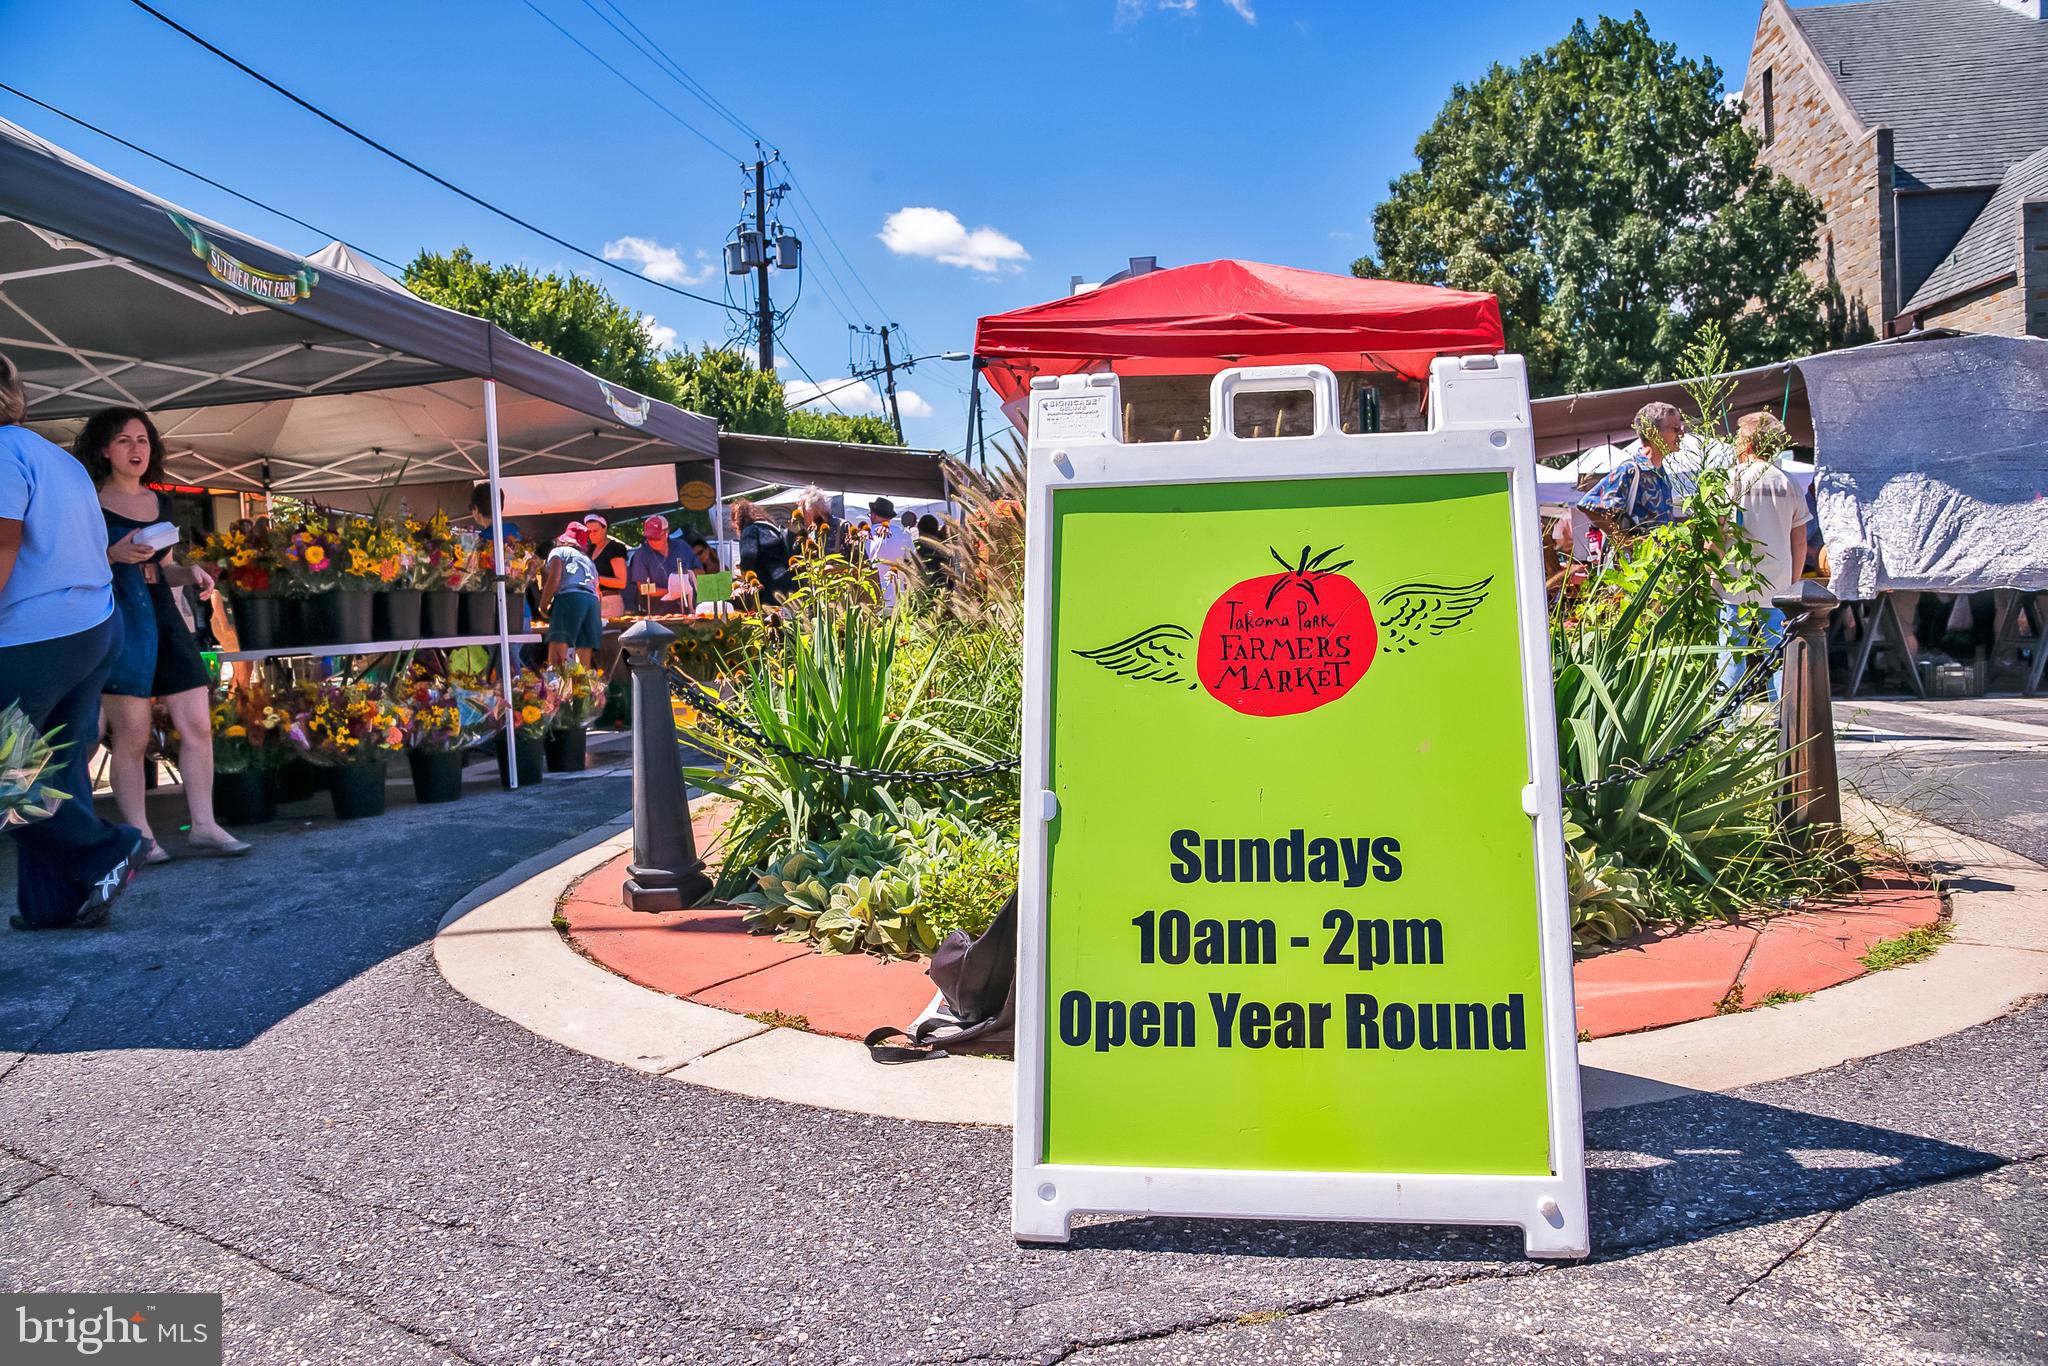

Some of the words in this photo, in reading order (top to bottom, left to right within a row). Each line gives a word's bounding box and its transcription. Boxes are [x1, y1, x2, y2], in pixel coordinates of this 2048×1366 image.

[210, 251, 250, 290] SUTTLER
[251, 275, 273, 298] POST
[274, 281, 296, 298] FARM
[1226, 600, 1290, 633] Takoma
[1219, 634, 1351, 661] FARMERS
[1213, 661, 1350, 695] MARKET
[1169, 828, 1403, 888] Sundays
[1131, 909, 1277, 965] 10am
[1290, 936, 1310, 948] -
[1322, 908, 1444, 971] 2pm
[1059, 990, 1196, 1053] Open
[1207, 992, 1332, 1049] Year
[1345, 993, 1527, 1051] Round
